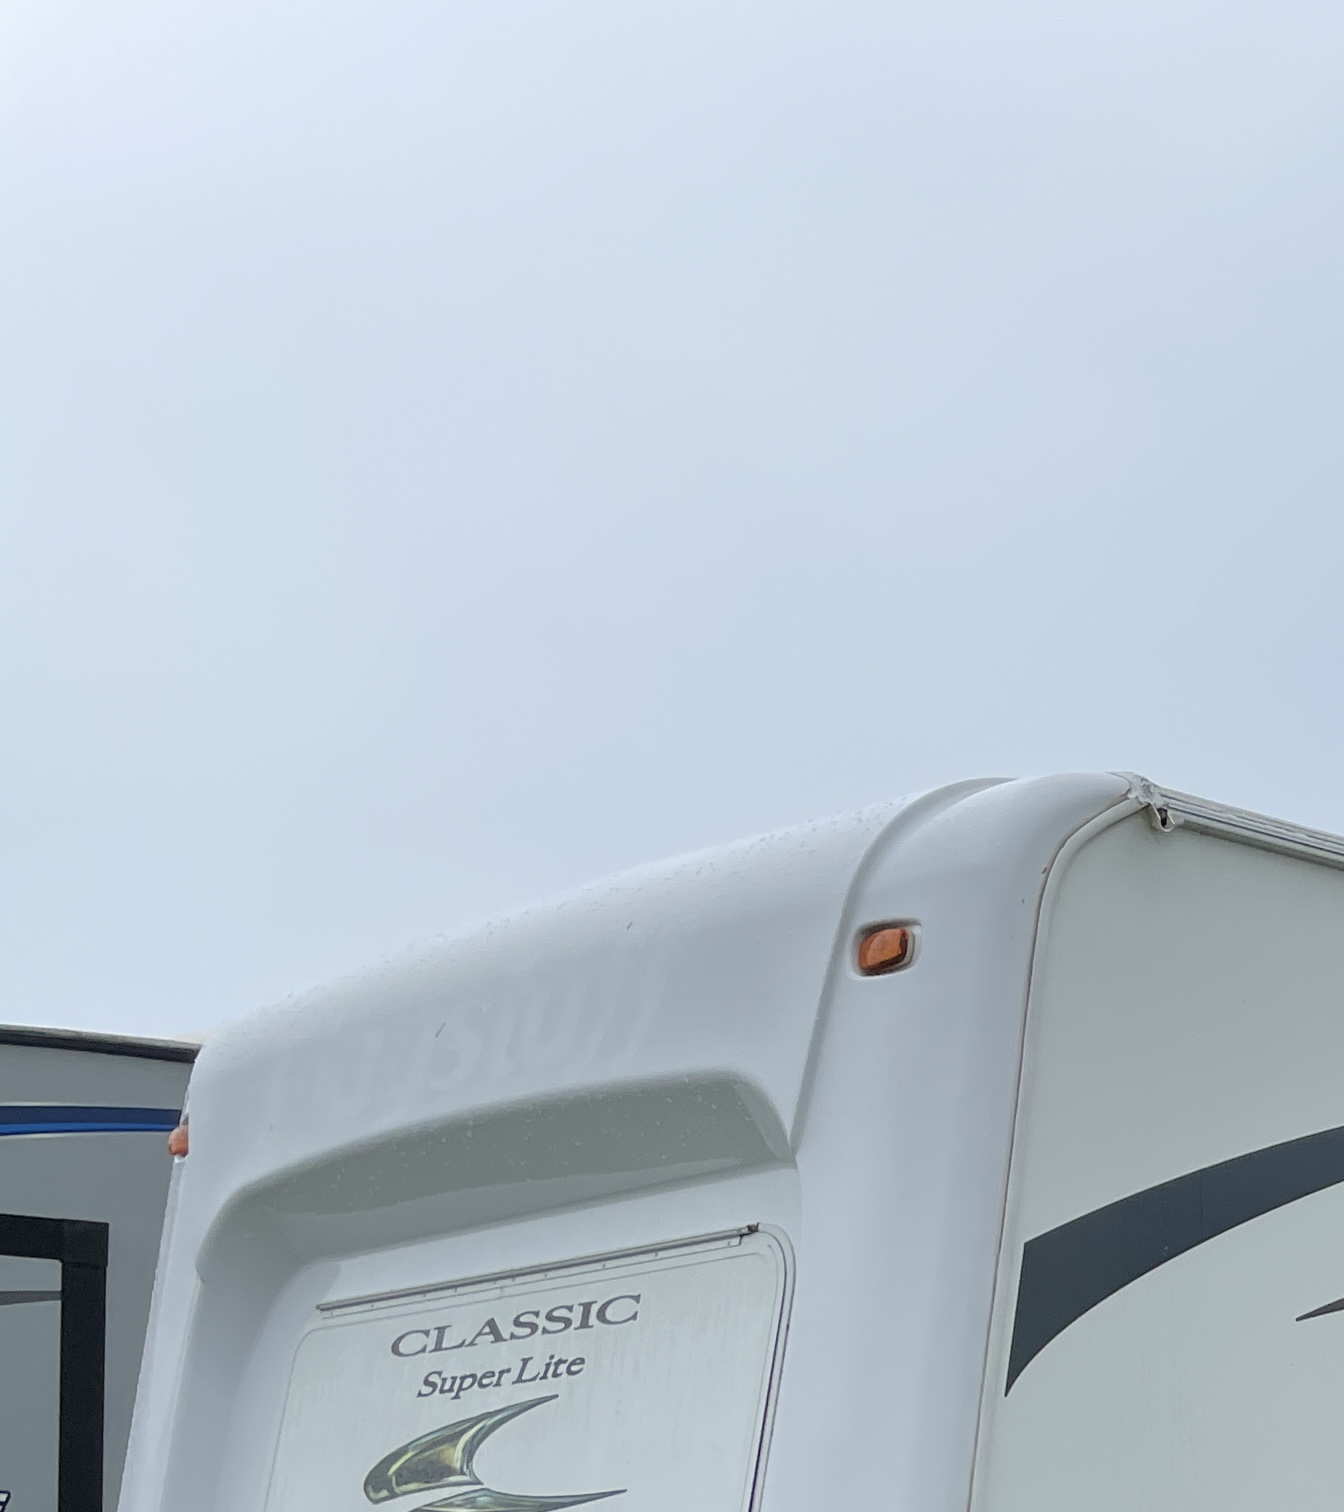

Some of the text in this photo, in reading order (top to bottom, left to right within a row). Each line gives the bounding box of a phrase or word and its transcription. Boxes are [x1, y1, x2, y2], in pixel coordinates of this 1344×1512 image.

[390, 1293, 641, 1358] CLASSIC
[416, 1354, 585, 1400] Super Lite
